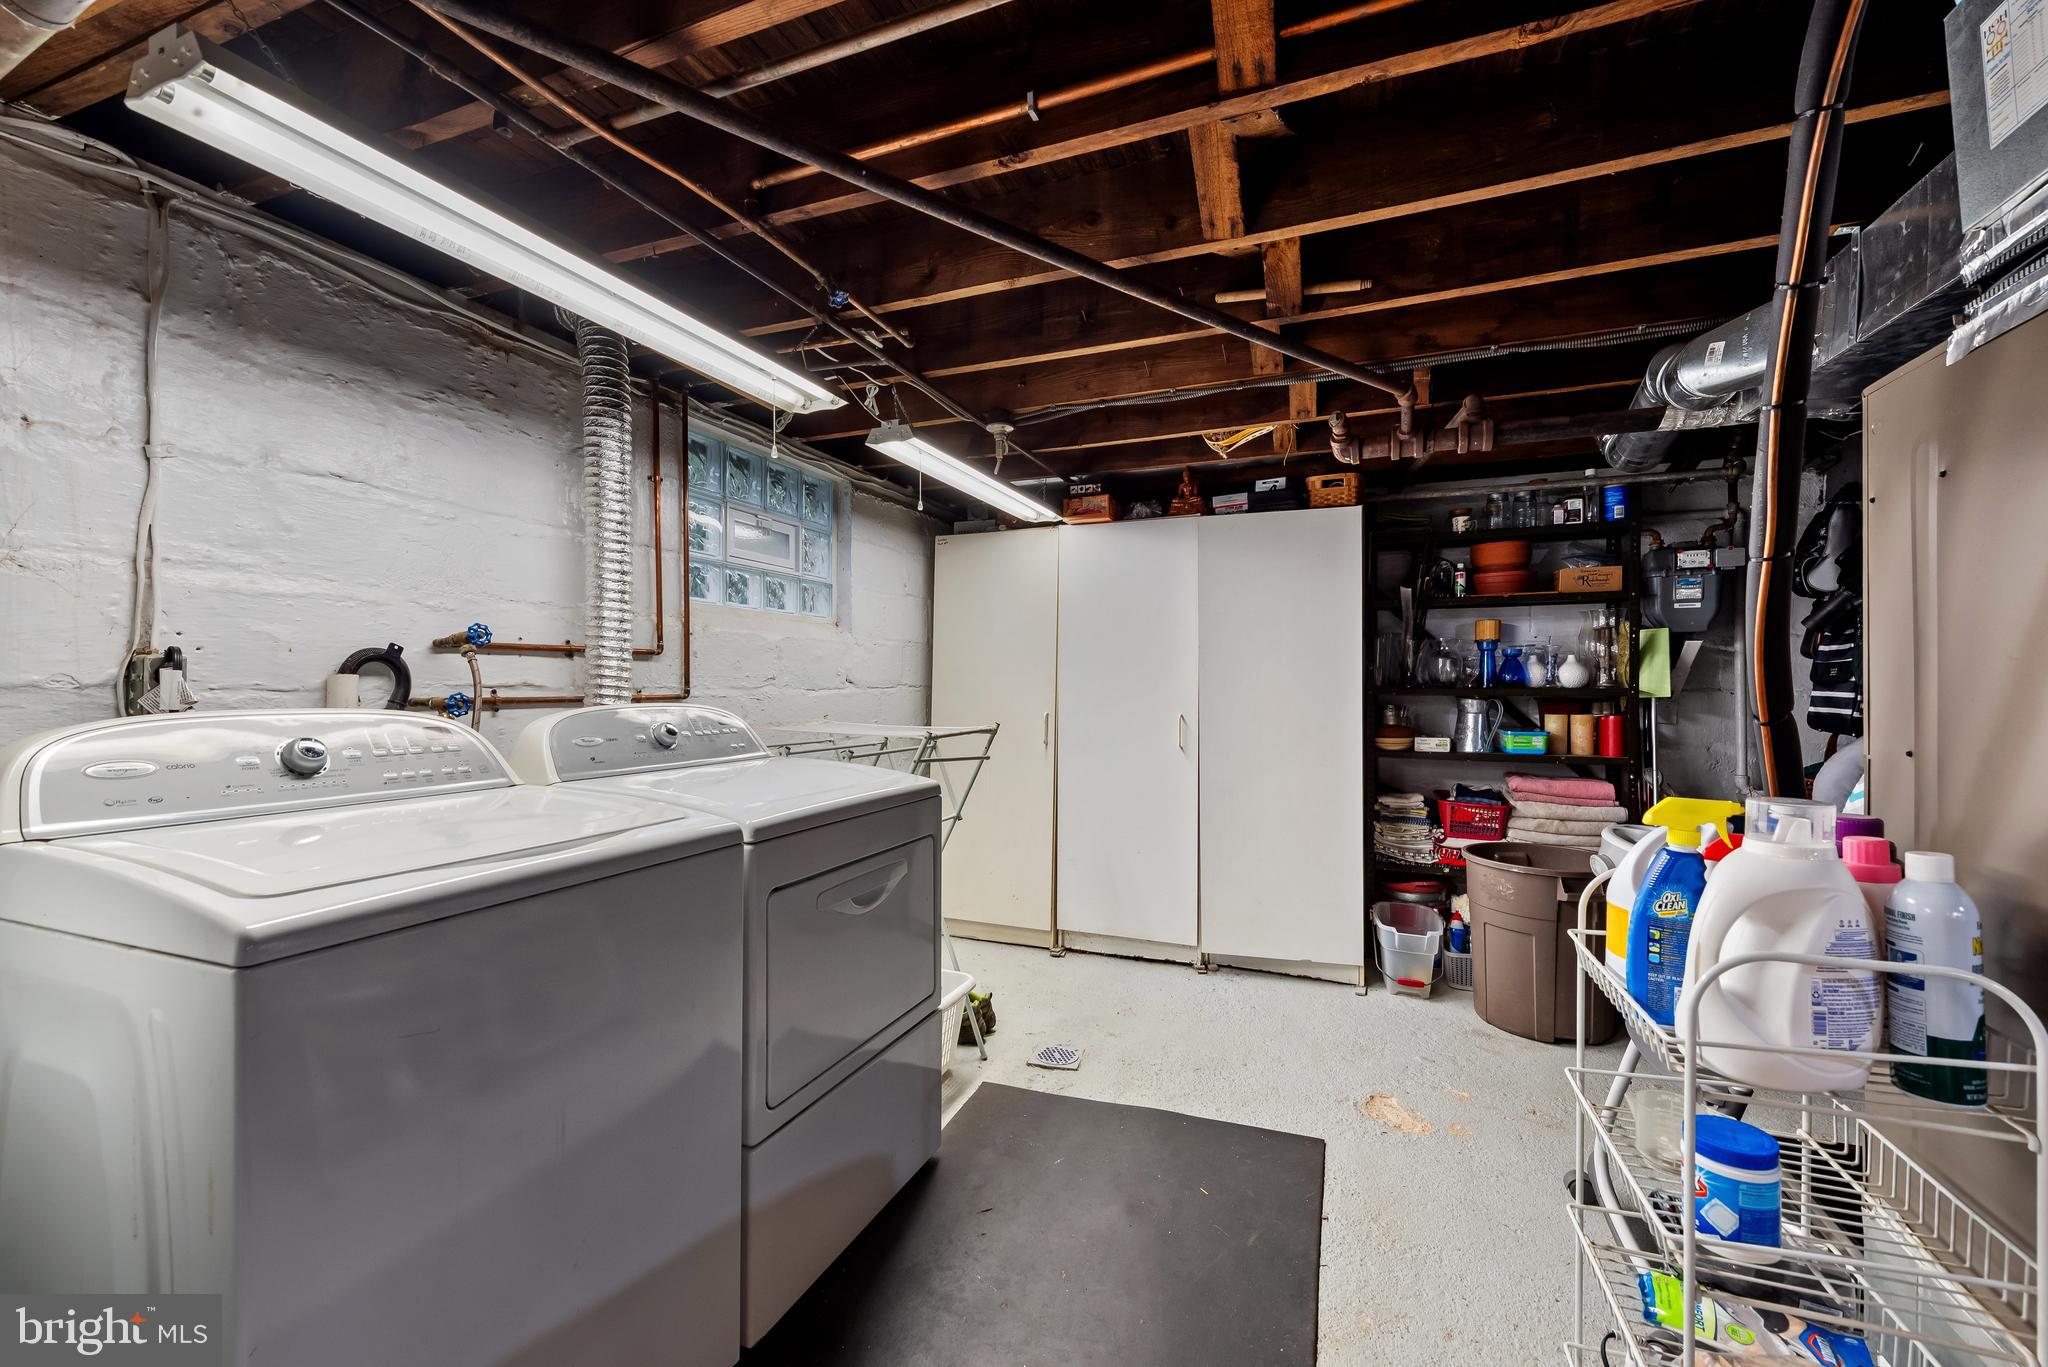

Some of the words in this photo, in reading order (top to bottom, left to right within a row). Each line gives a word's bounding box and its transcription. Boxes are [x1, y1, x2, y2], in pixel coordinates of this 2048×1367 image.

[1661, 892, 1680, 902] OXI
[1654, 900, 1686, 911] CLEAN
[1897, 910, 1916, 921] FINISH
